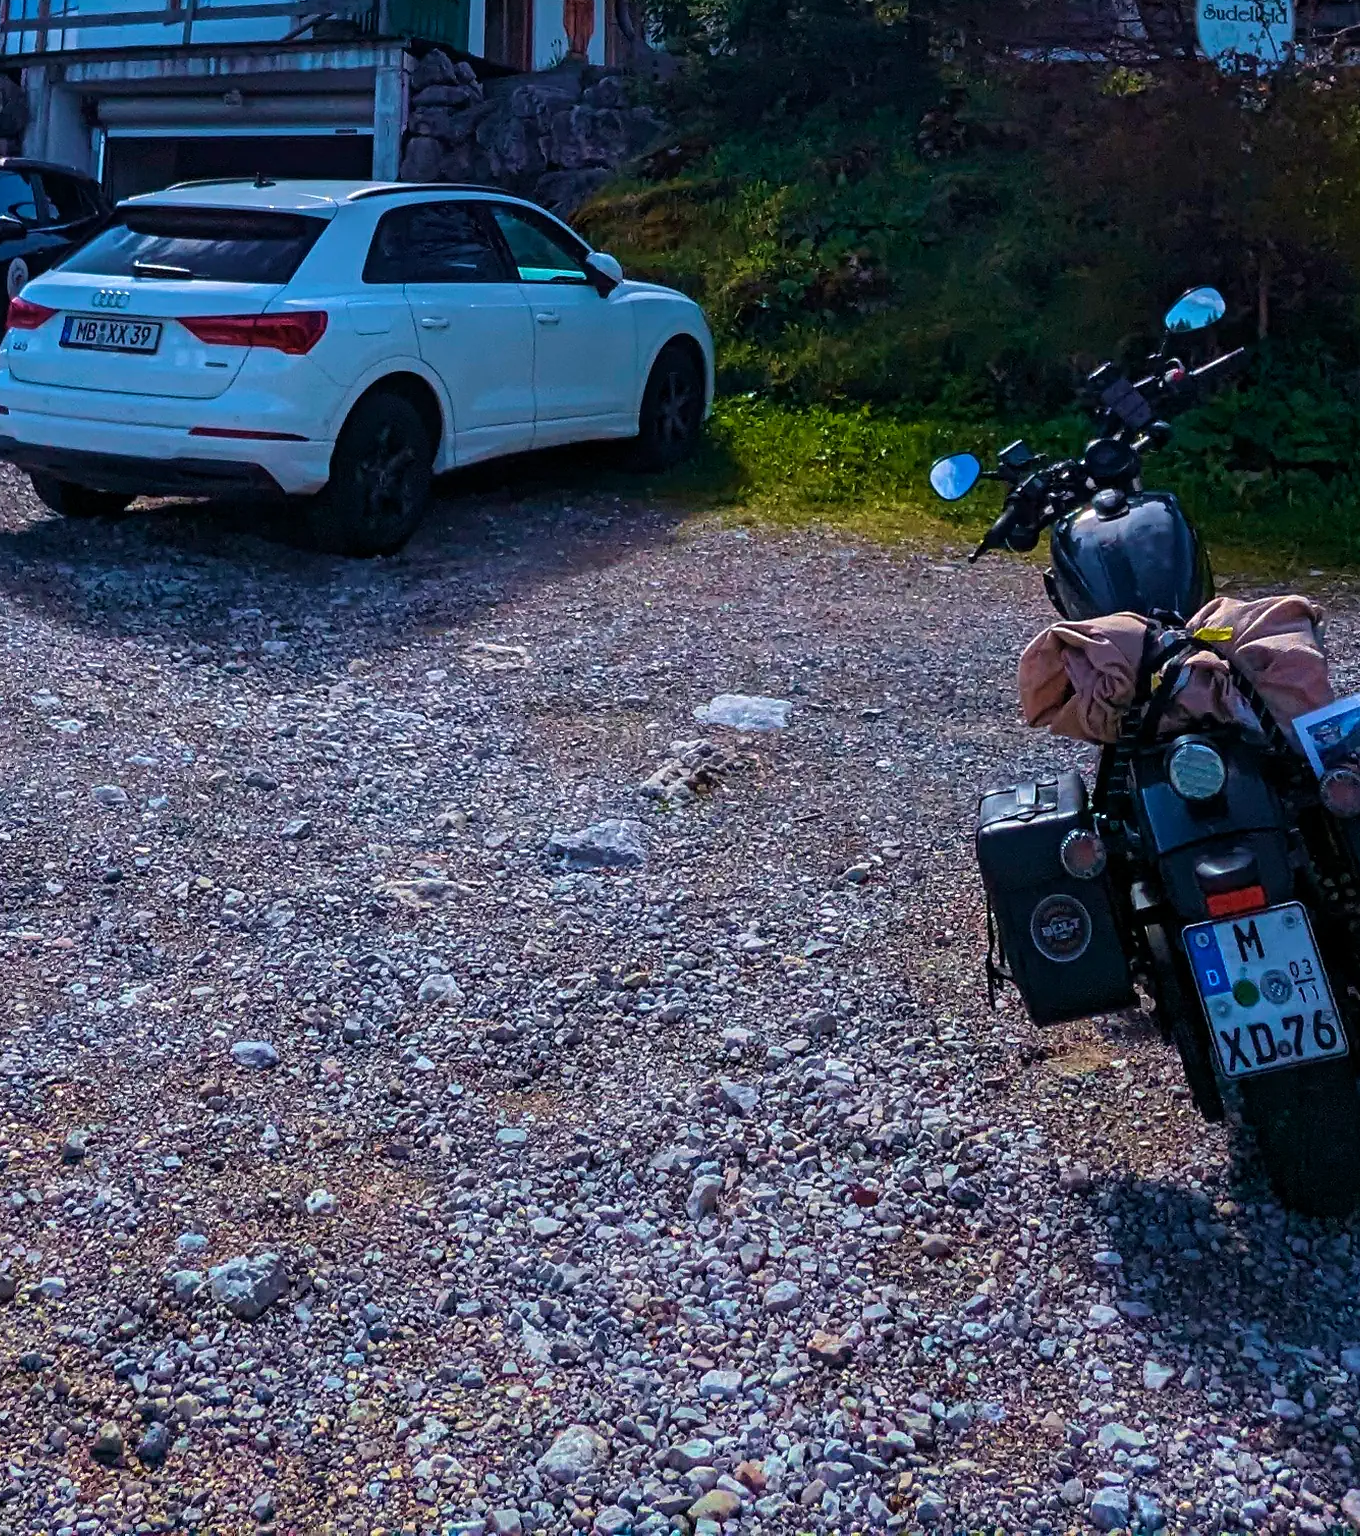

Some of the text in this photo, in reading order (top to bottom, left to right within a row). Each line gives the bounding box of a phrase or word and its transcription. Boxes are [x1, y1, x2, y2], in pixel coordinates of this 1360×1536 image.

[76, 322, 152, 346] MB XX 39
[1233, 920, 1265, 962] M
[1206, 969, 1221, 986] D
[1220, 1009, 1337, 1072] XD 76
